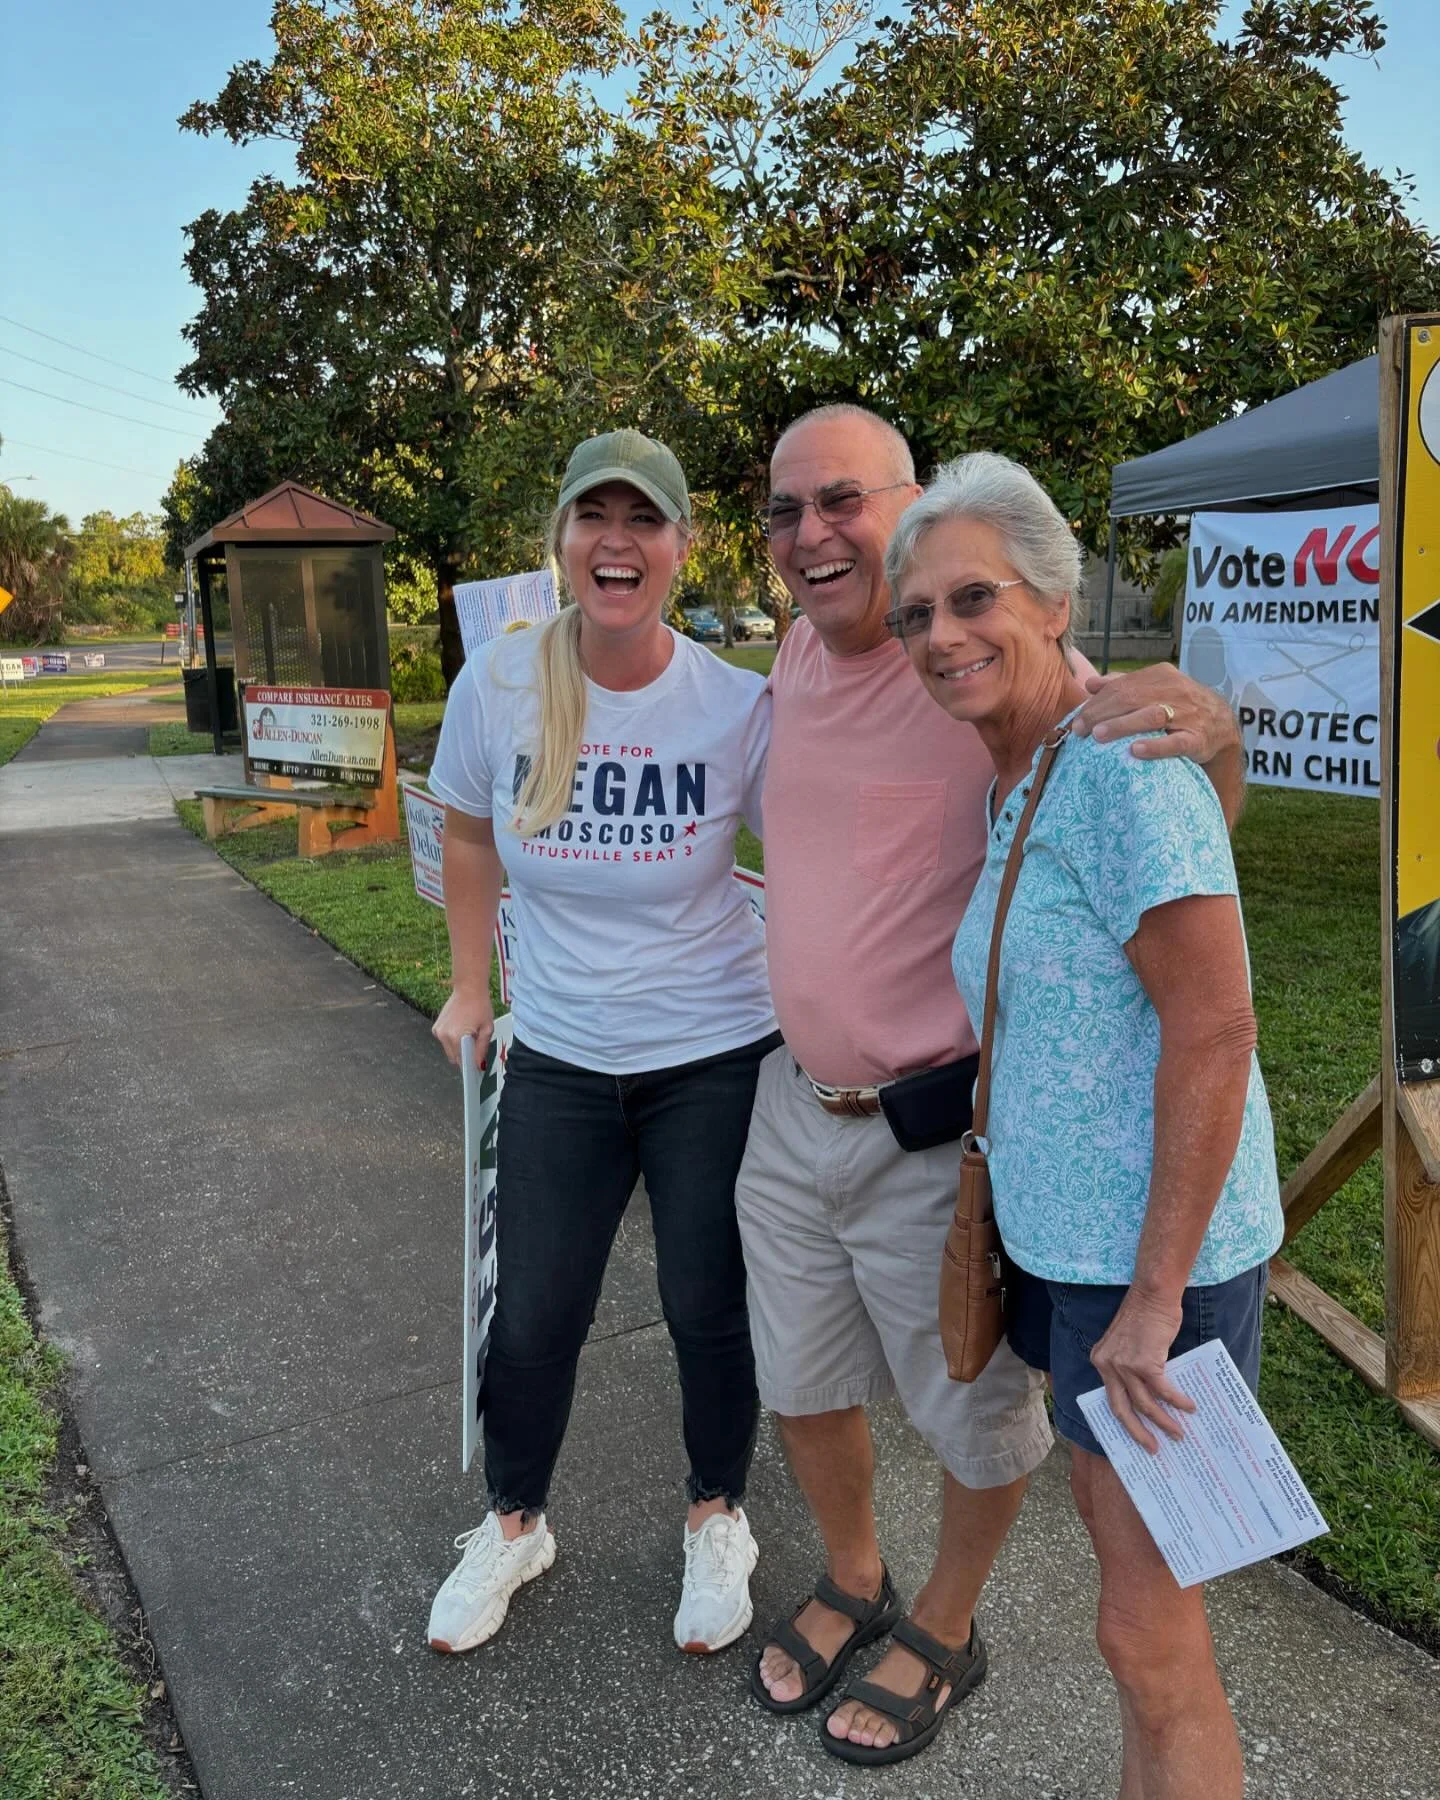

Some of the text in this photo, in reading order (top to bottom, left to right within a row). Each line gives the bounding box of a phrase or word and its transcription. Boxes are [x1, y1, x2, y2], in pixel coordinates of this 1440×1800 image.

[1192, 545, 1285, 589] Vote
[1186, 599, 1380, 624] ON AMENDMEN
[257, 692, 372, 706] COMPARE INSURANCE RATES
[1239, 707, 1378, 744] PROTEC
[310, 749, 376, 766] AllenDuncan.com
[580, 744, 654, 758] OTE FOR
[282, 764, 299, 774] AUTO
[312, 768, 326, 777] LIFE
[340, 770, 374, 783] BUSINESS
[1245, 750, 1380, 786] RN CHIL
[408, 802, 430, 829] Katie
[522, 842, 692, 862] TITUSVILLE SEAT 3
[1215, 1372, 1244, 1416] General Election
[1217, 1351, 1227, 1363] This
[1227, 1370, 1238, 1382] your
[1235, 1382, 1250, 1404] SAMPLE
[1248, 1405, 1263, 1426] BALLOT
[1225, 1377, 1244, 1404] November
[1285, 1470, 1301, 1492] BOLETA
[1302, 1499, 1321, 1526] MUESTRA
[1294, 1498, 1309, 1518] General
